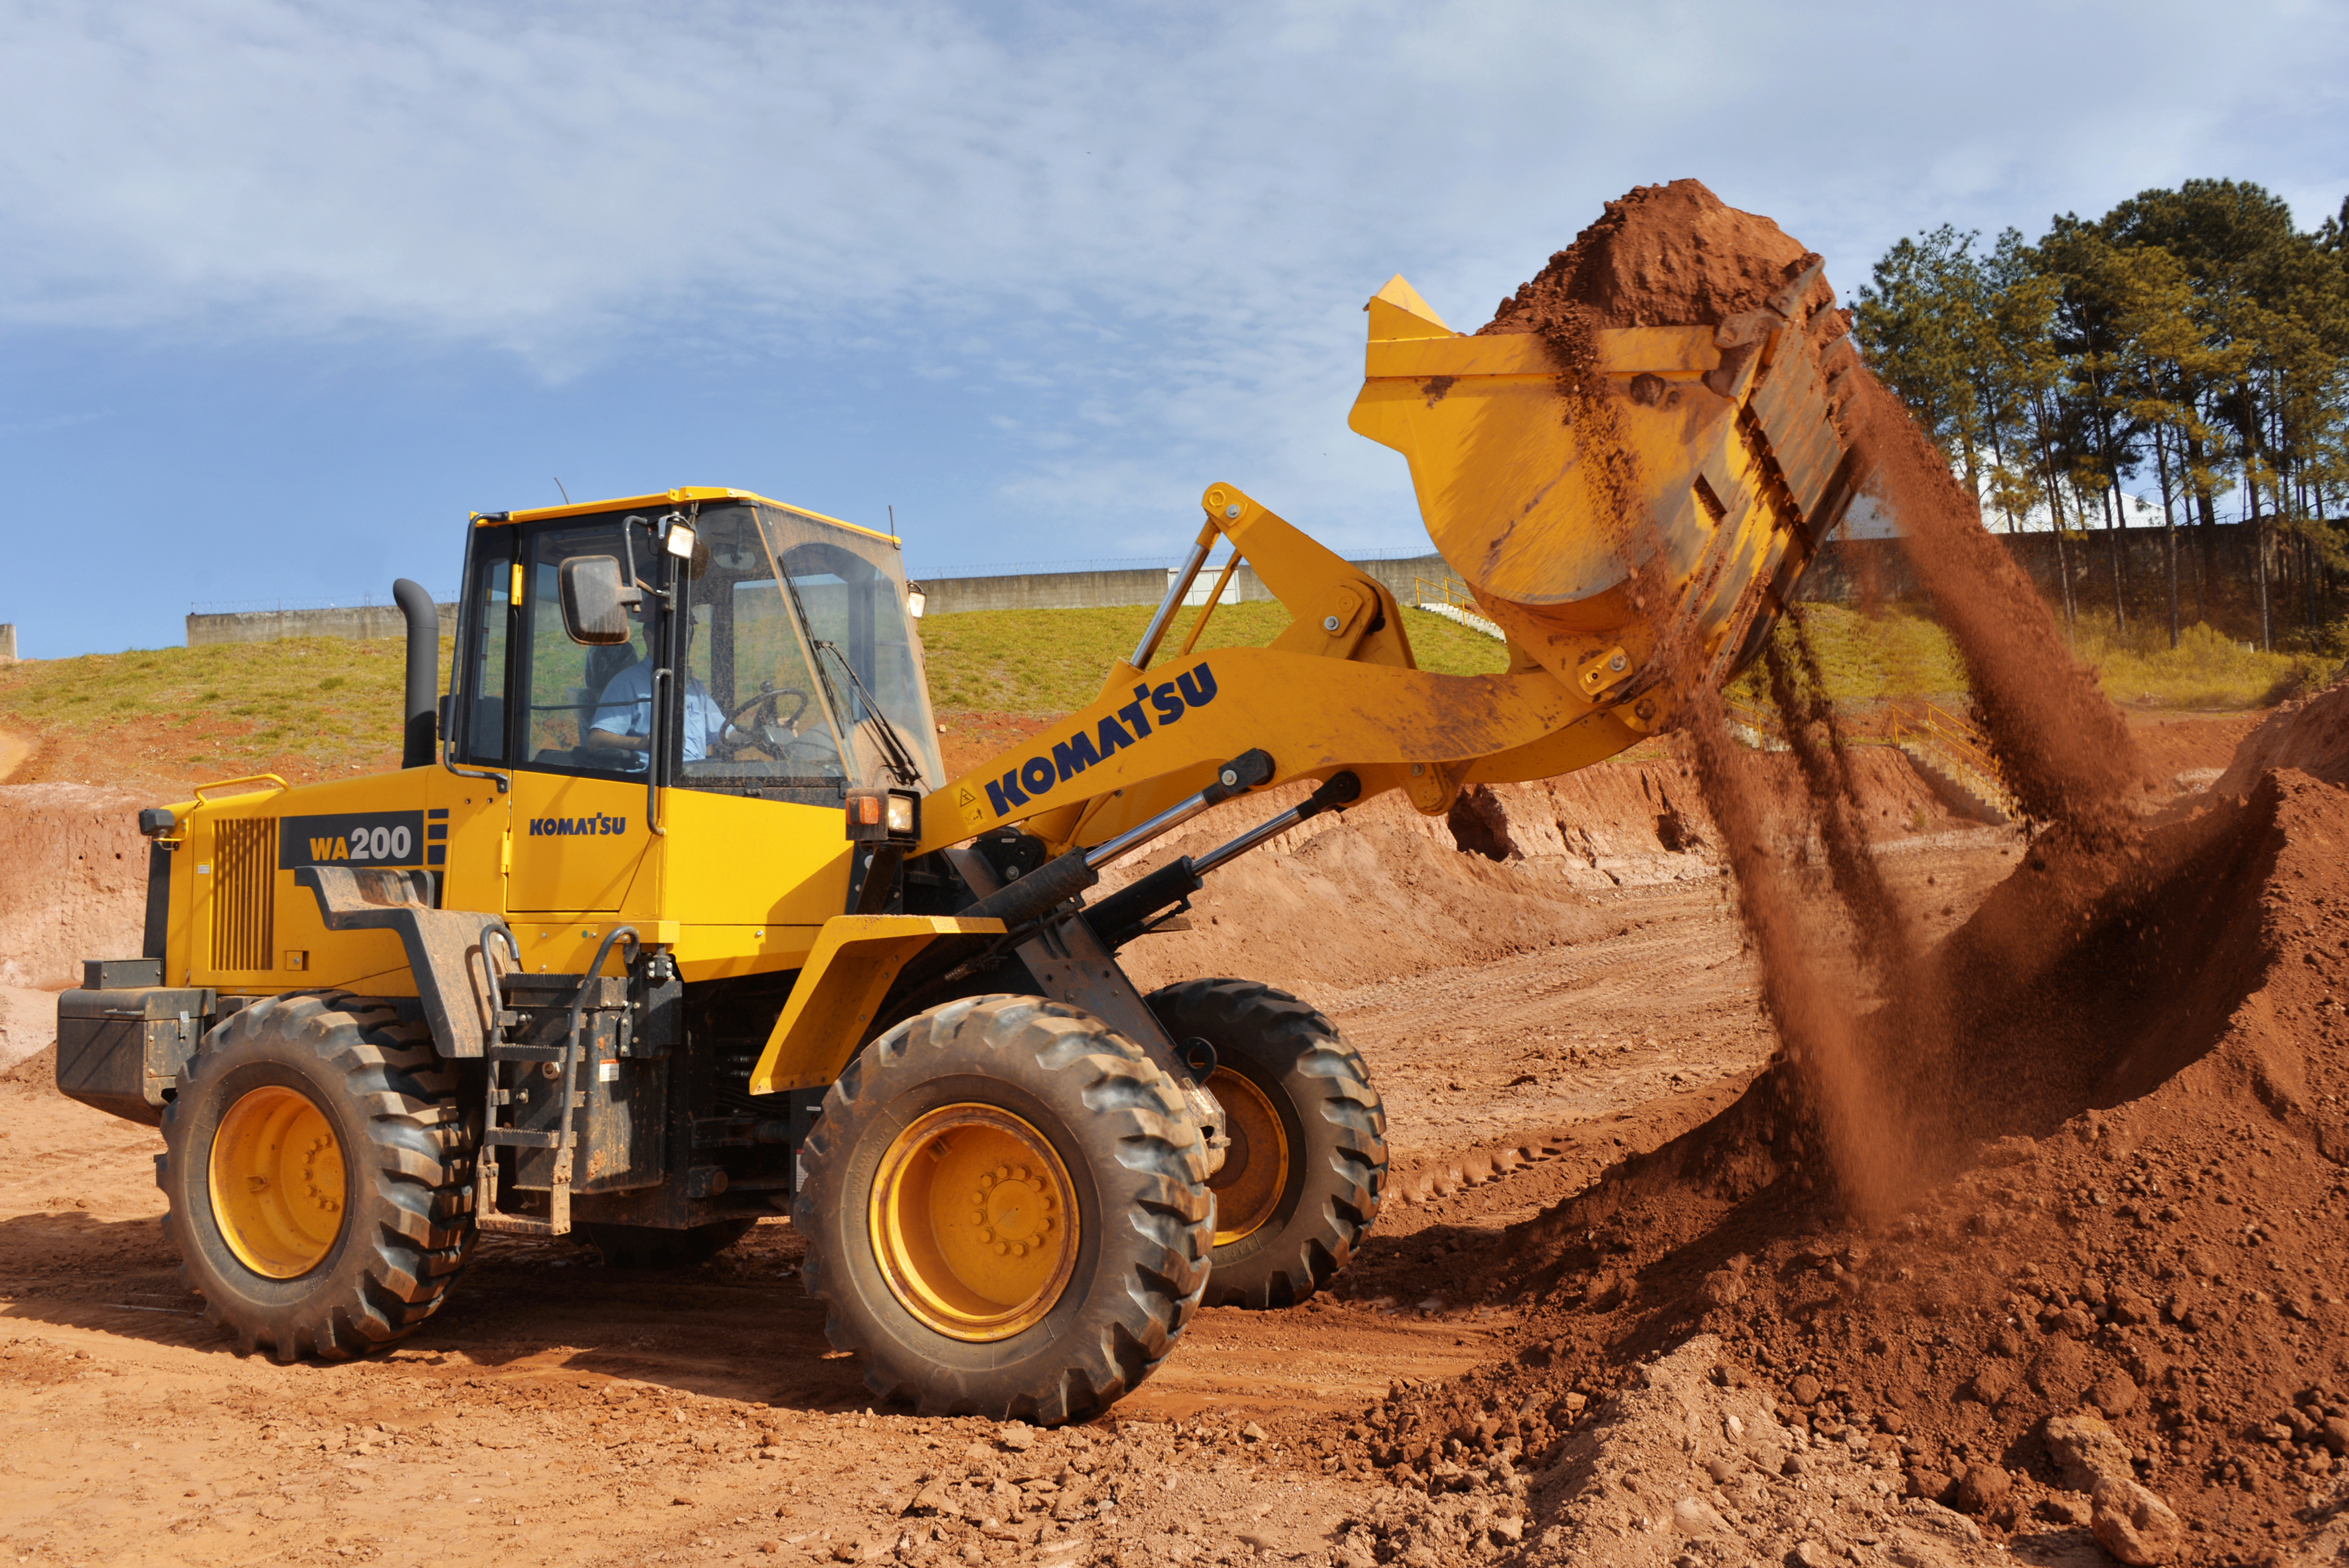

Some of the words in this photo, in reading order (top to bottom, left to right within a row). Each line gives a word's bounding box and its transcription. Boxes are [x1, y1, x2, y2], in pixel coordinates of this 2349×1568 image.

[984, 661, 1218, 818] KOMATSU
[529, 812, 626, 836] KOMATSU
[309, 825, 412, 861] WA200
